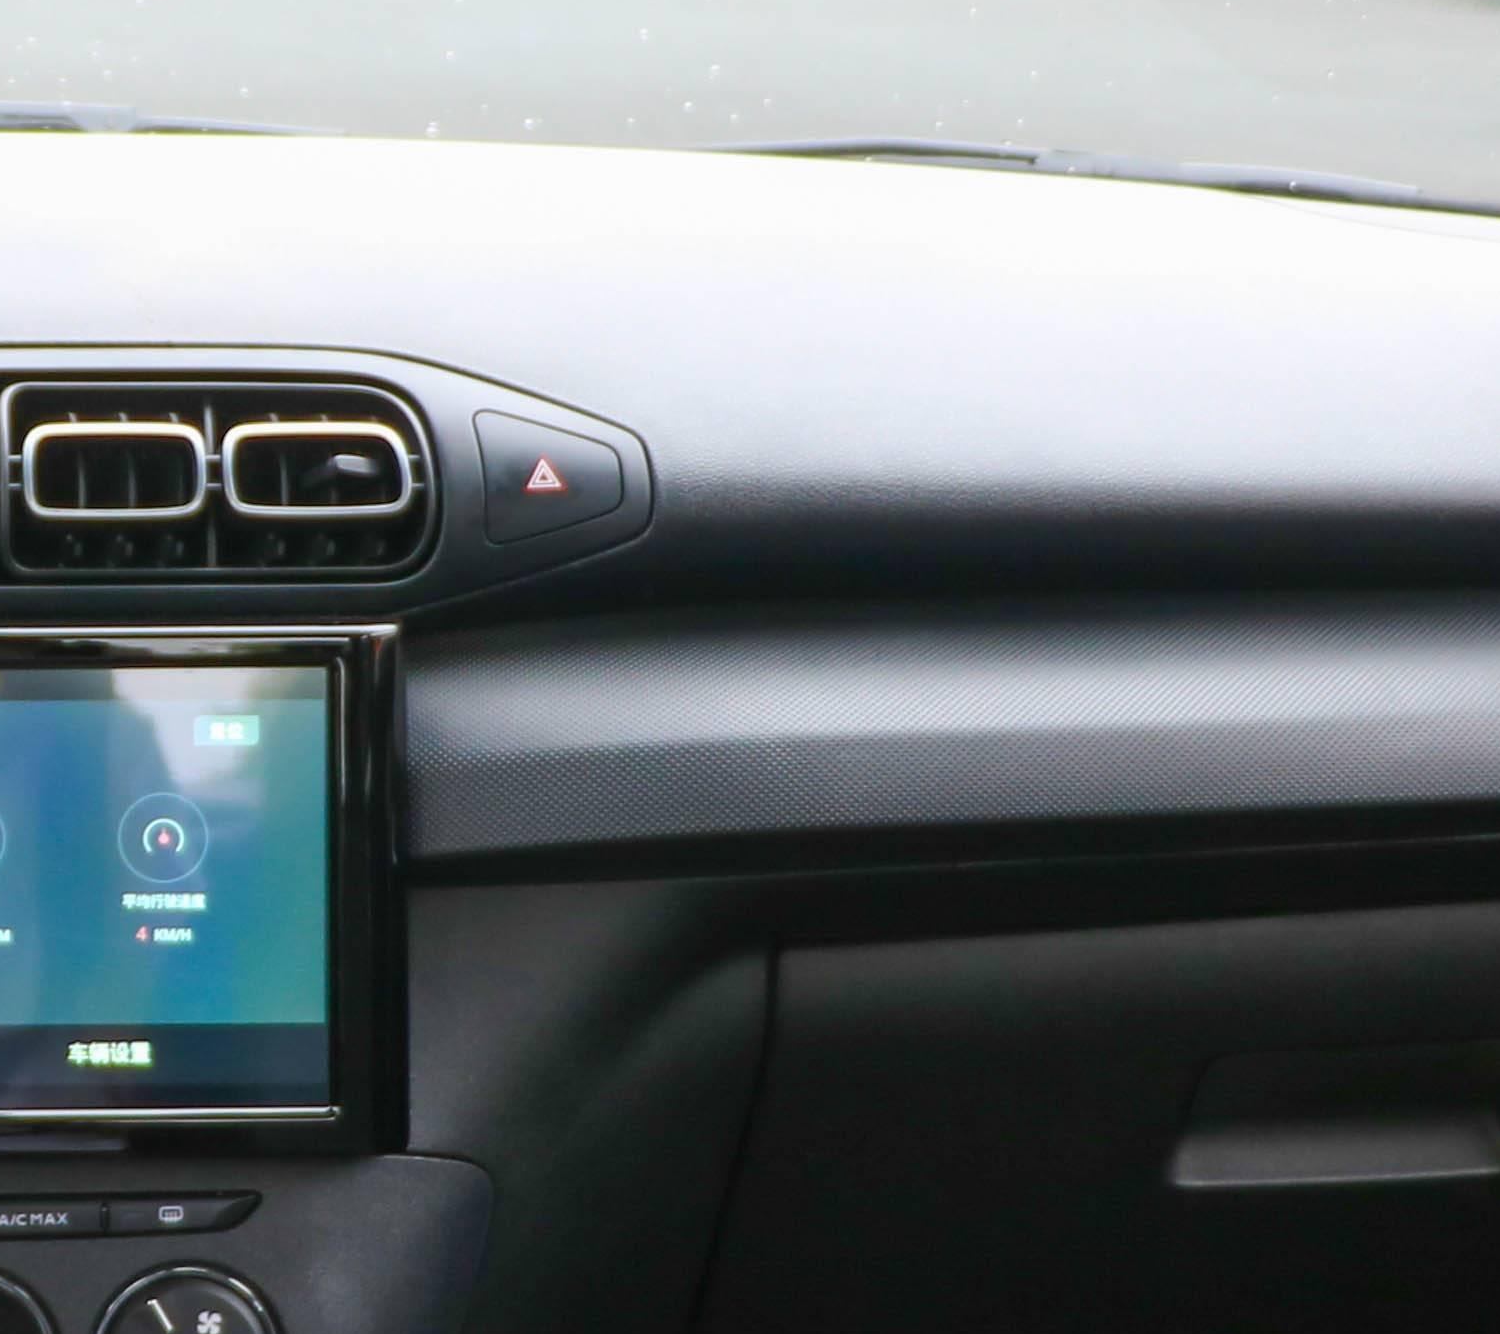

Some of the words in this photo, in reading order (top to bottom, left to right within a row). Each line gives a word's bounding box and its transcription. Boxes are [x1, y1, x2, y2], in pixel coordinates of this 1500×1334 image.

[136, 926, 148, 941] 4
[67, 1041, 152, 1065] 车辆设置
